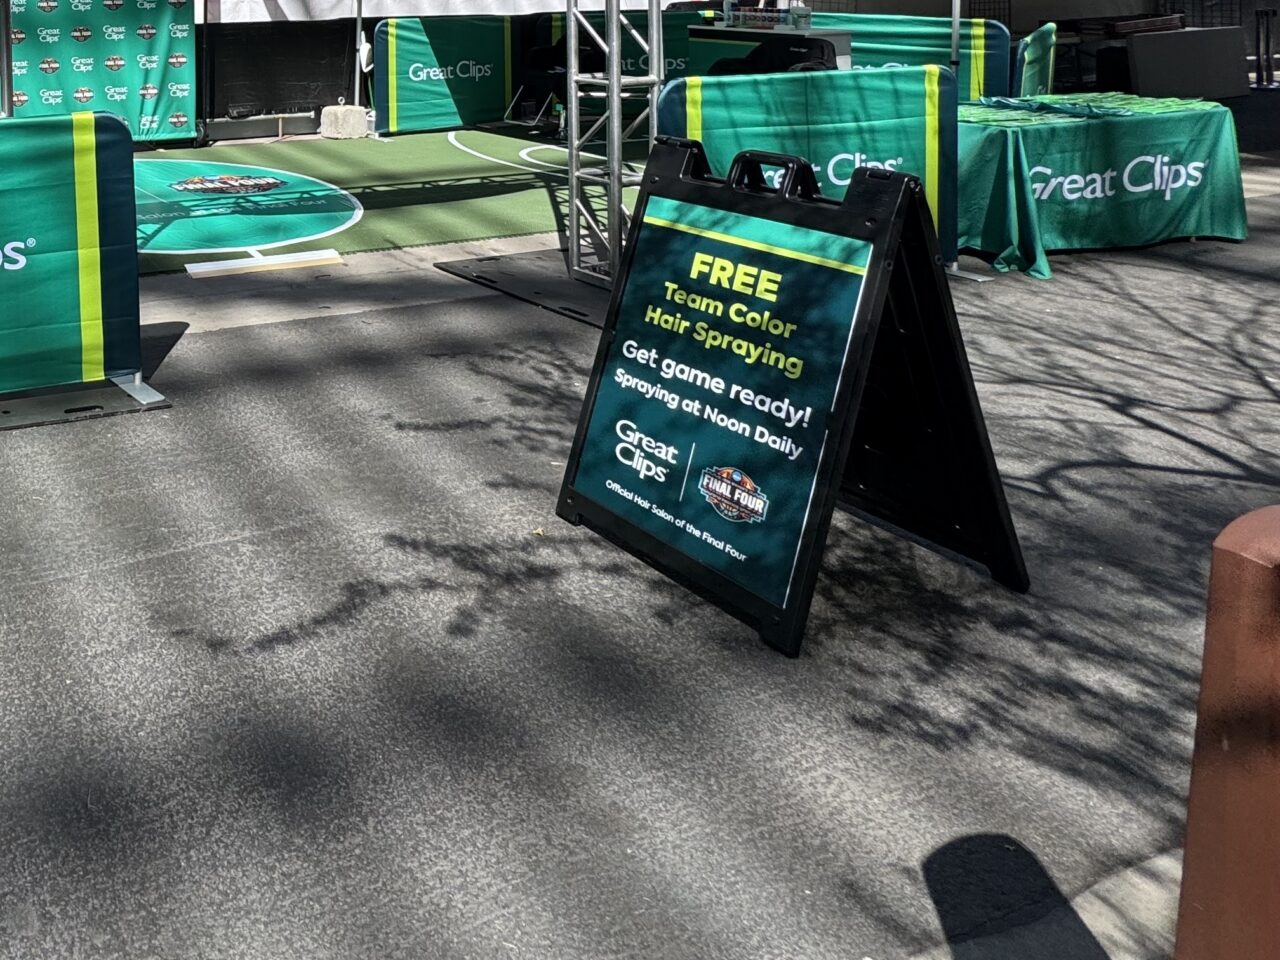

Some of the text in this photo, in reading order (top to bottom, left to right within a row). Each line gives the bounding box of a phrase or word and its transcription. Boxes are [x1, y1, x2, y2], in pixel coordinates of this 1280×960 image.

[71, 3, 92, 12] Clips
[136, 1, 157, 10] Clips
[103, 25, 127, 33] Great
[169, 23, 190, 31] Great
[37, 28, 61, 36] Great
[104, 32, 126, 41] Clips
[170, 30, 189, 39] Clips
[38, 35, 60, 44] Clips
[71, 57, 95, 65] Great
[137, 55, 160, 63] Great
[72, 64, 94, 73] Clips
[138, 62, 159, 70] Clips
[408, 63, 454, 82] Great
[105, 86, 129, 94] Great
[168, 83, 192, 91] Great
[40, 90, 64, 98] Great
[106, 93, 128, 102] Clips
[169, 90, 191, 99] Clips
[41, 97, 63, 106] Clips
[1030, 154, 1205, 200] Great Clips
[689, 252, 783, 302] FREE
[664, 281, 797, 338] Team Color
[644, 304, 803, 379] Hair Spraying
[622, 340, 812, 428] Get game ready!
[614, 368, 804, 461] Spraying at Noon Daily
[615, 419, 679, 464] Great
[614, 442, 667, 482] Clips
[703, 474, 764, 513] FINAL FOUR
[605, 480, 748, 562] Official Hair Salon of the Final Four
